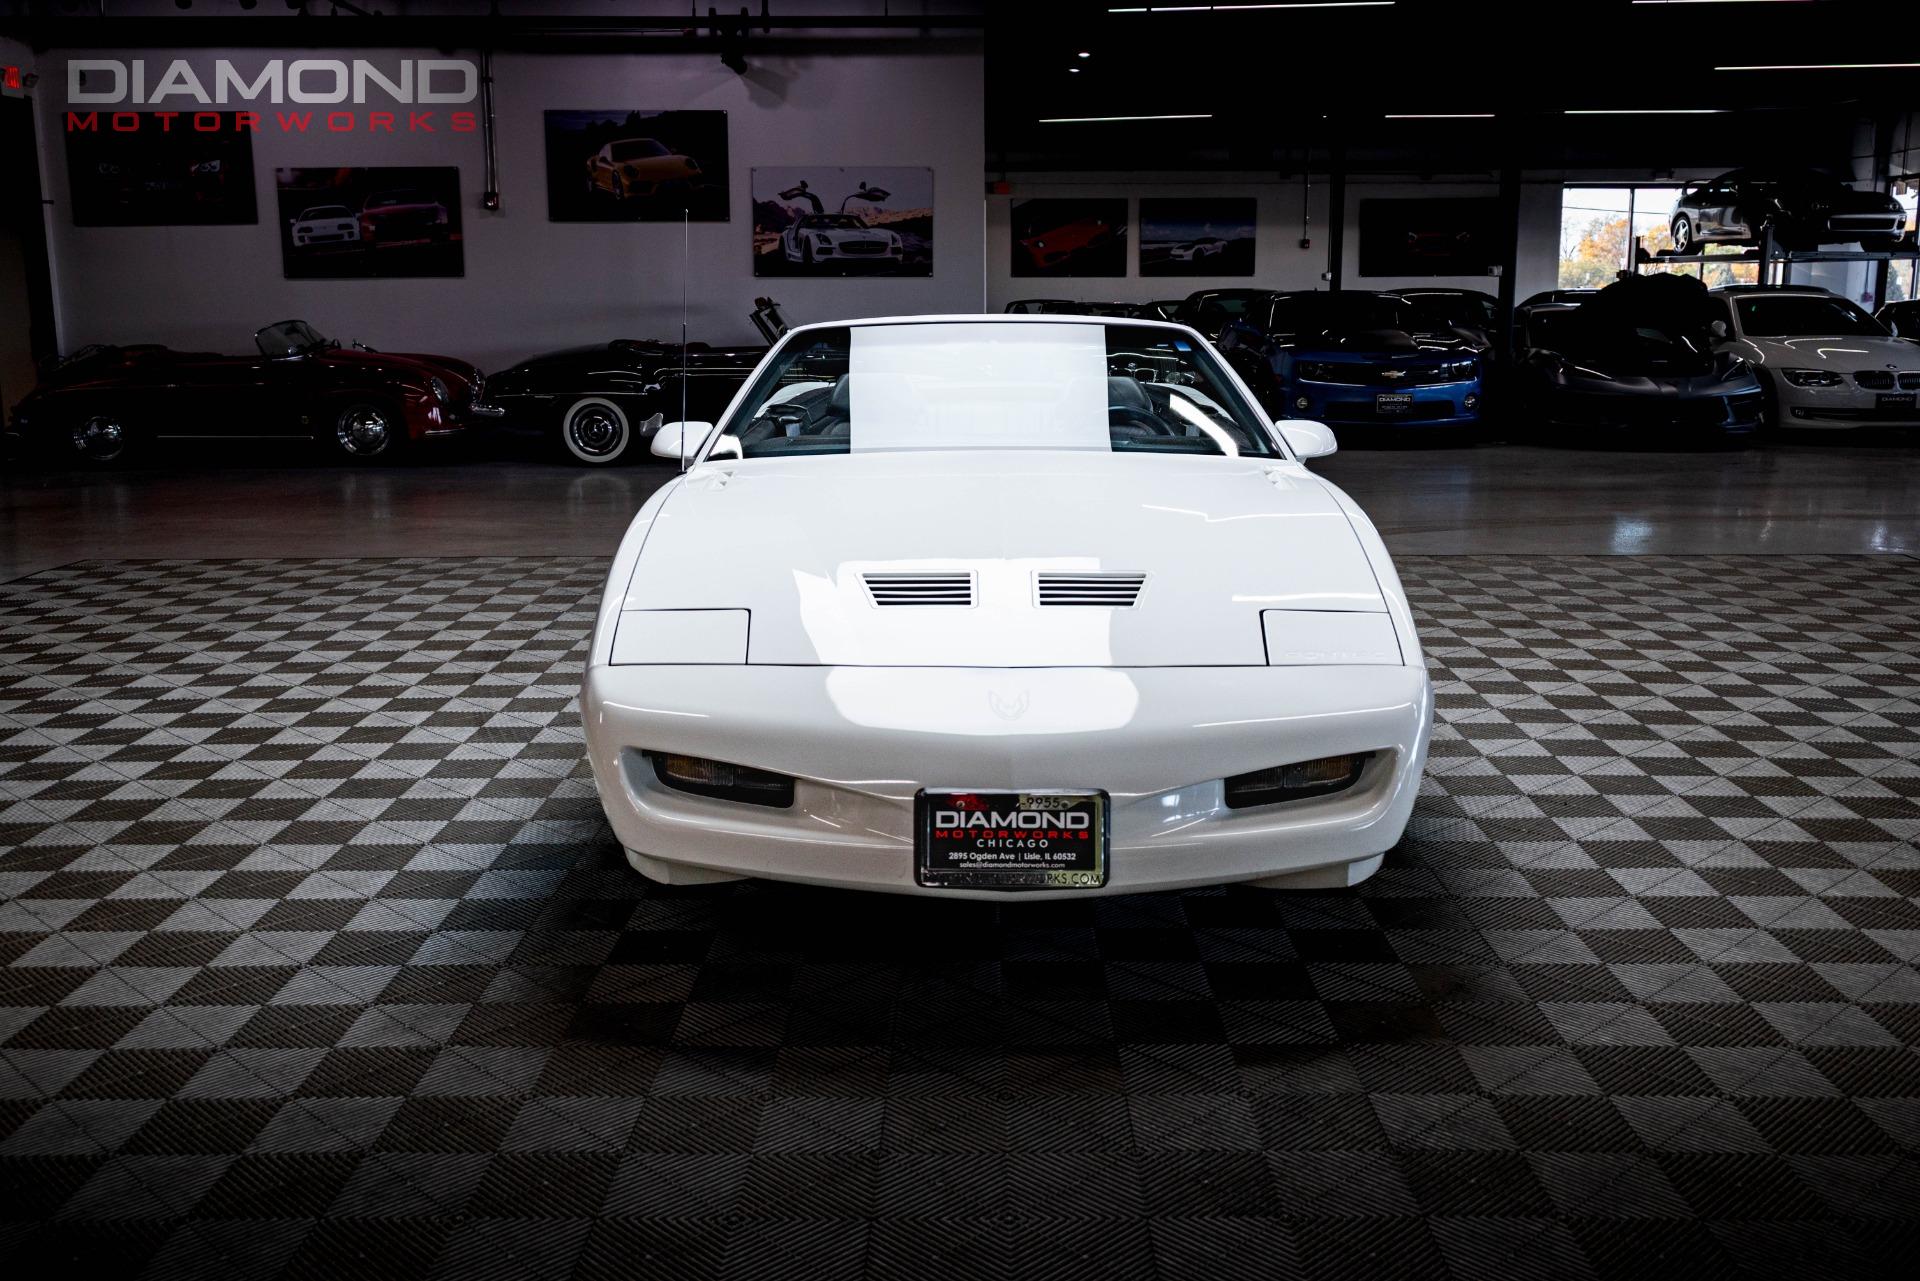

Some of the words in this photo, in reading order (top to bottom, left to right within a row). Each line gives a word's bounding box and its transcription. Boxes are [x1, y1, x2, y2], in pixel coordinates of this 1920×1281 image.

[935, 811, 1090, 829] DIAMOND
[935, 830, 1089, 839] MOTORWORKS
[976, 838, 1049, 848] CHICAGO
[948, 852, 967, 860] 2895
[969, 852, 997, 862] Ogden
[999, 852, 1016, 860] Ave
[1044, 852, 1051, 860] IL
[1052, 852, 1077, 861] 60532
[959, 861, 1065, 869] sales@diamondmotorworks.com
